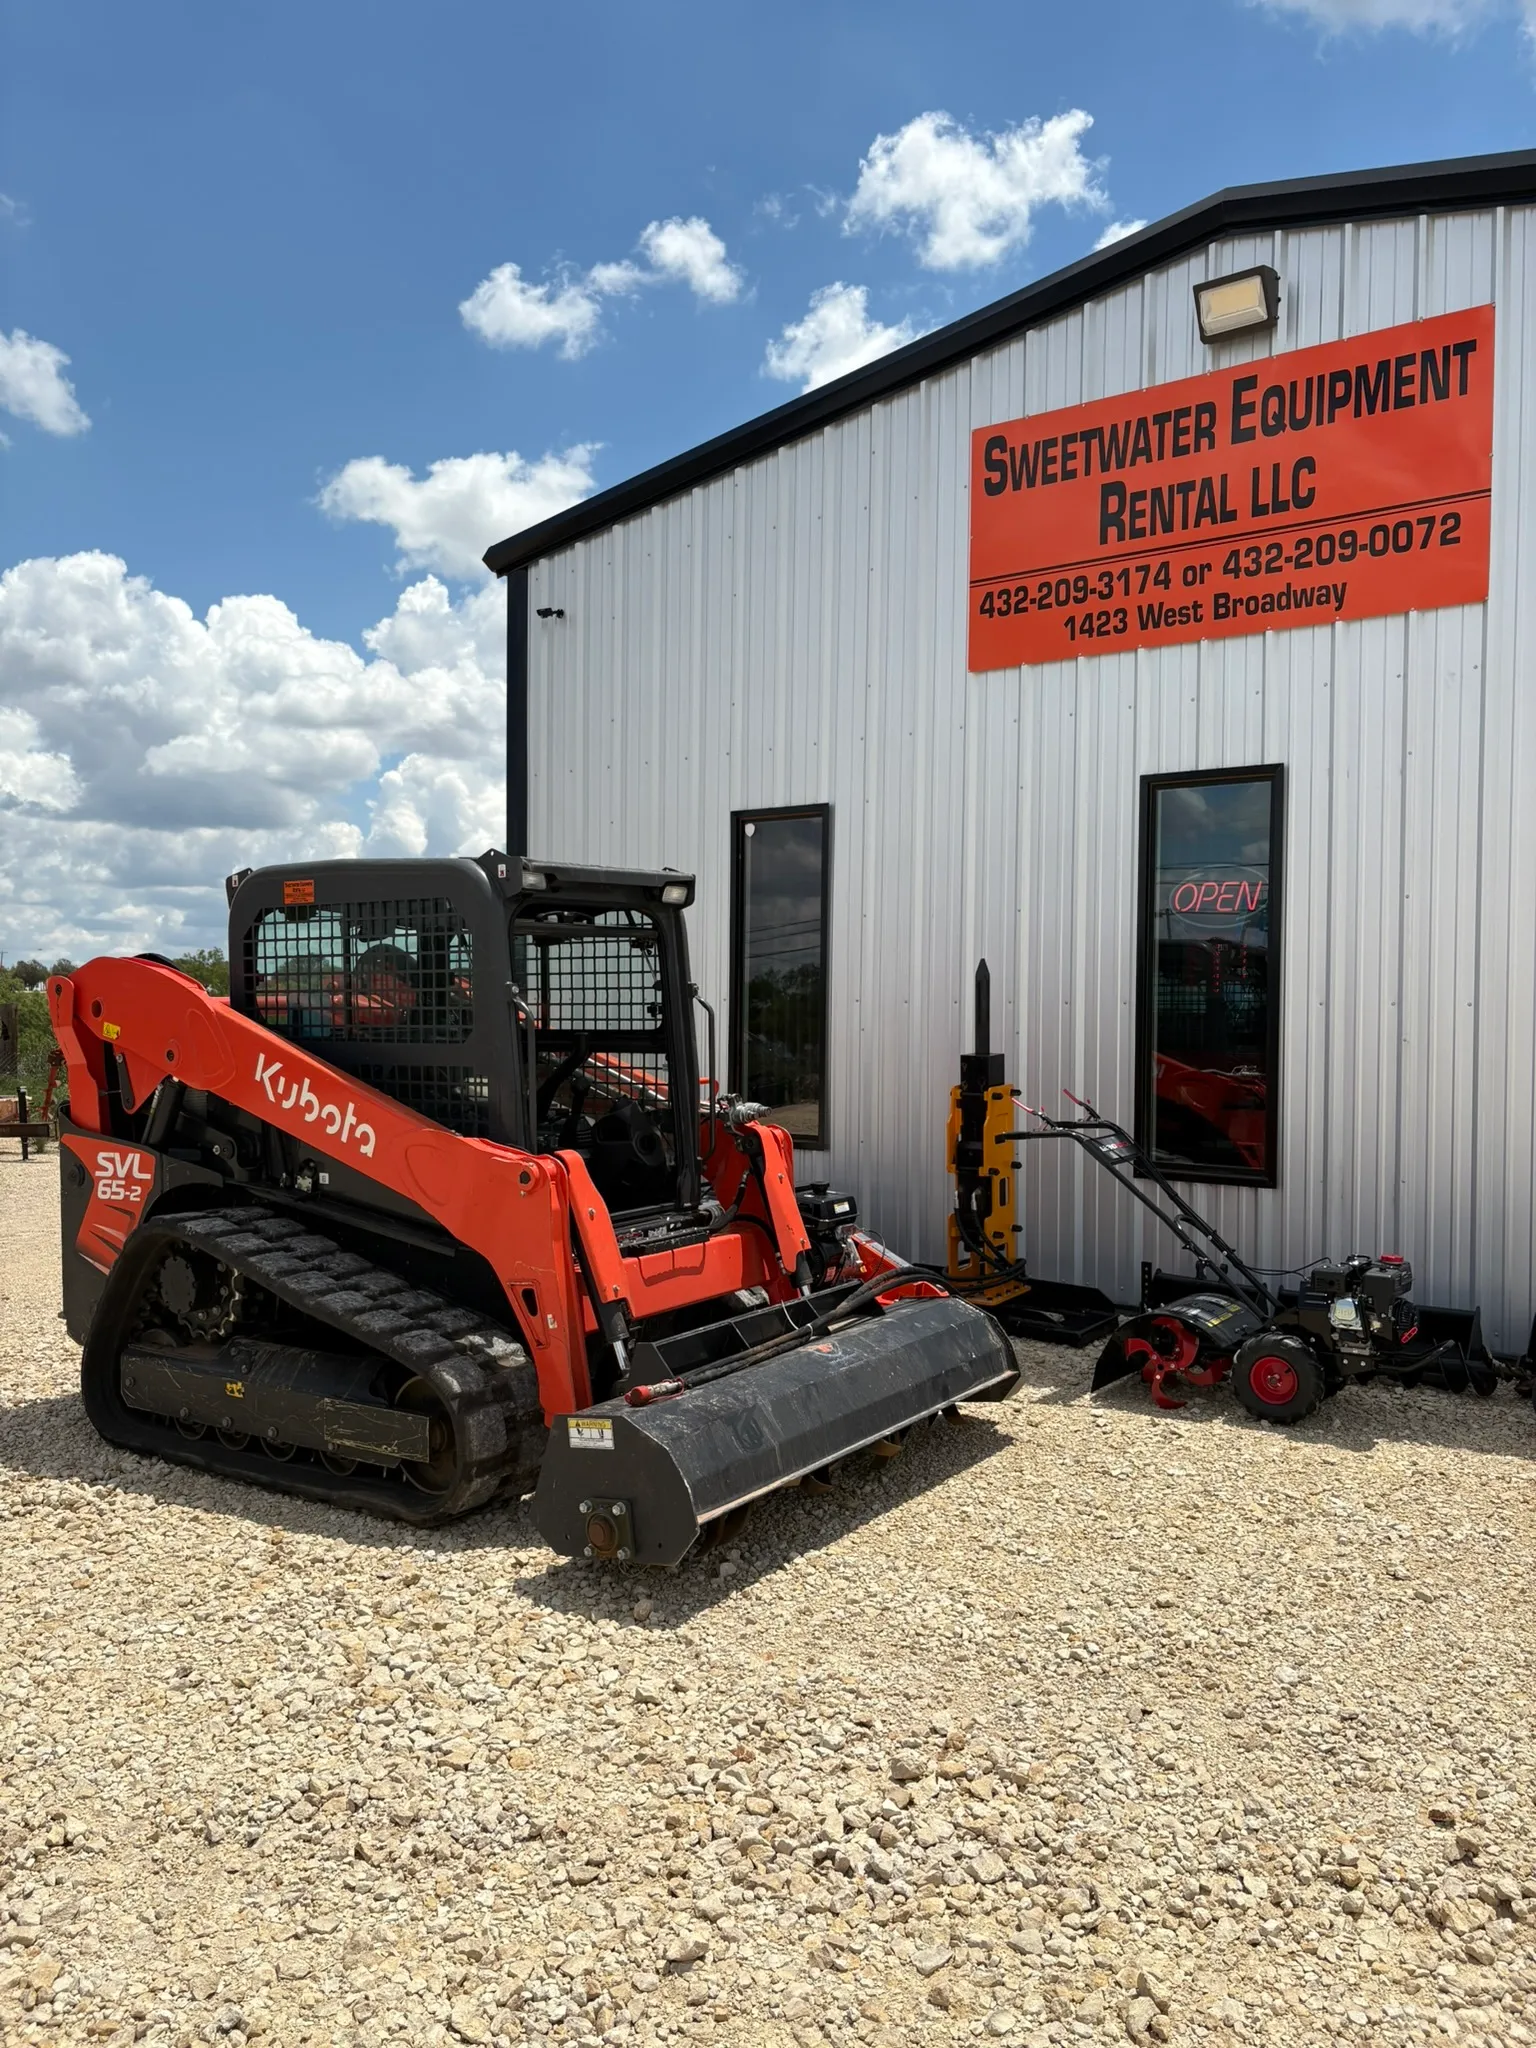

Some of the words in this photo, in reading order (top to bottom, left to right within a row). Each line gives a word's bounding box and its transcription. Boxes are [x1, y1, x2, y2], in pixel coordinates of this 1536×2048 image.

[984, 402, 1216, 496] SWEETWATER
[1231, 339, 1477, 444] EQUIPMENT
[1100, 477, 1237, 545] RENTAL
[1251, 456, 1316, 518] LLC
[980, 561, 1171, 618] 432-209-3174
[1183, 563, 1213, 588] or
[1223, 511, 1461, 579] 432-209-0072
[1064, 608, 1128, 641] 1423
[1137, 601, 1204, 630] West
[1213, 582, 1347, 621] Broadway
[1174, 880, 1263, 912] OPEN
[255, 1052, 377, 1158] Kubota
[95, 1152, 152, 1180] SVL
[97, 1179, 142, 1202] 65-2
[581, 1420, 607, 1428] WARNING
